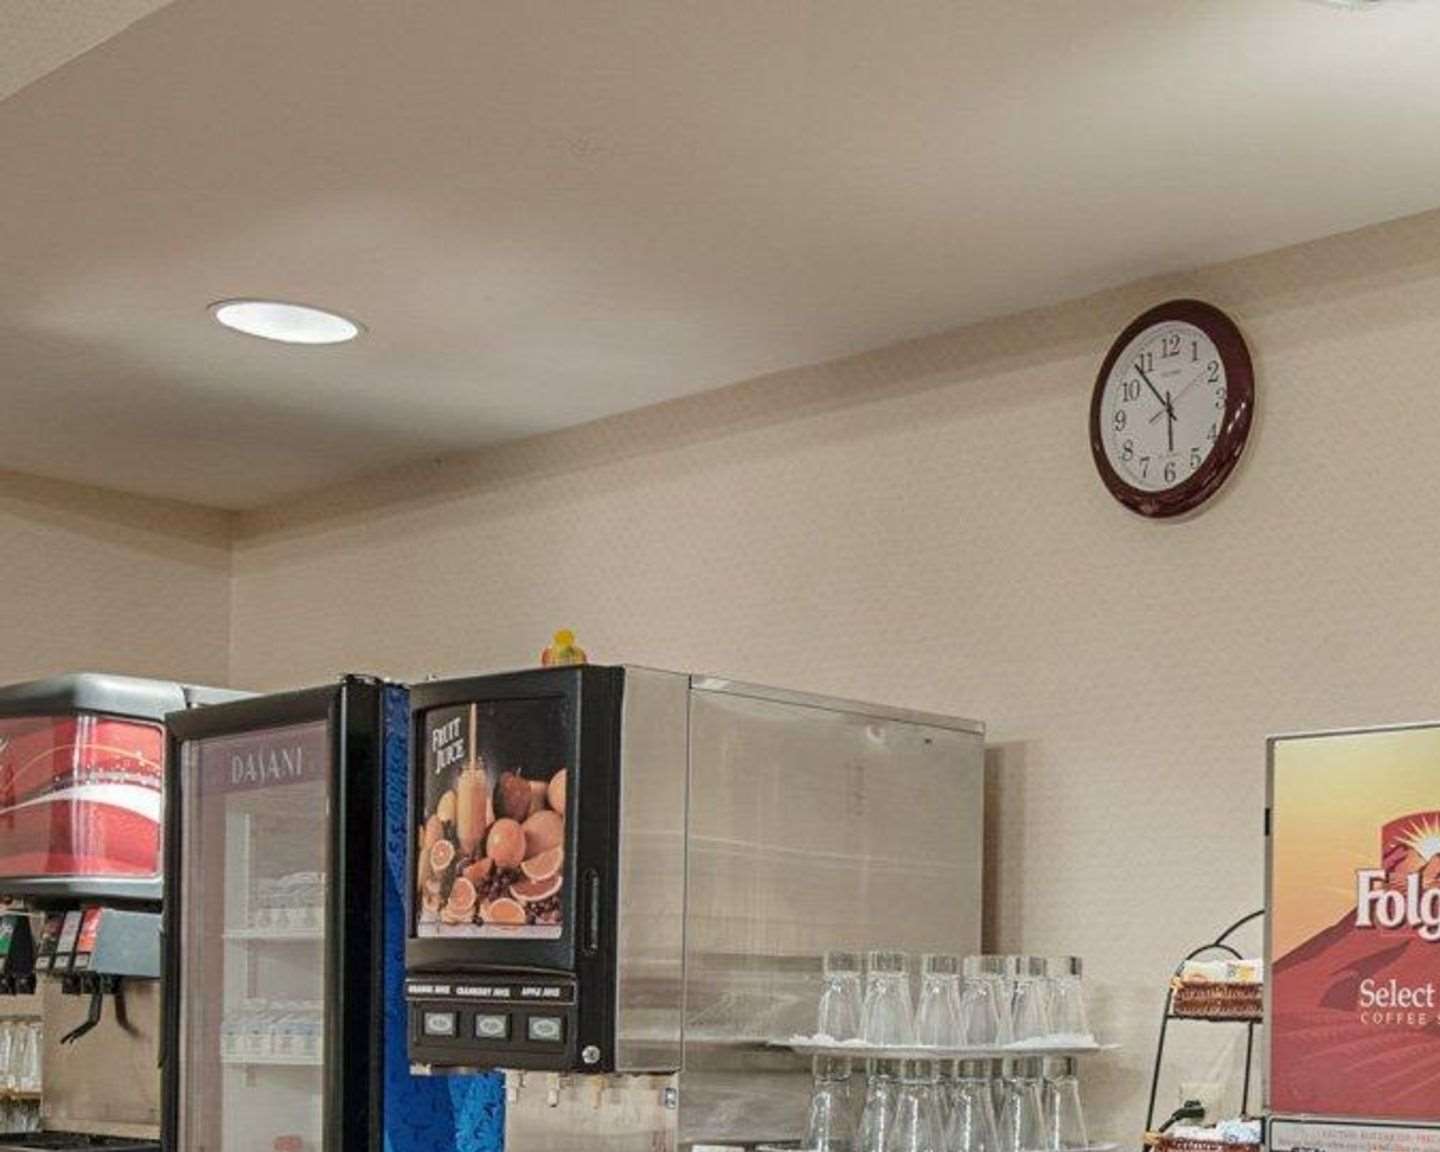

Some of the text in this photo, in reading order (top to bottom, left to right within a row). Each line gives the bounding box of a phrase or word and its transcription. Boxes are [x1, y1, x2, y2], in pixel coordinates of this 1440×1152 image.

[1162, 334, 1181, 358] 12
[1190, 341, 1198, 361] 1
[1140, 352, 1153, 373] 11
[1207, 361, 1219, 383] 2
[1123, 379, 1141, 402] 10
[1215, 387, 1227, 409] 3
[1115, 410, 1126, 432] 9
[1121, 440, 1134, 461] 8
[1190, 447, 1201, 469] 5
[1139, 456, 1150, 478] 7
[1164, 462, 1176, 483] 6
[231, 745, 303, 784] DASANI
[435, 738, 464, 775] JUICE
[1360, 979, 1435, 1009] Select
[1360, 1012, 1427, 1025] COFFEE
